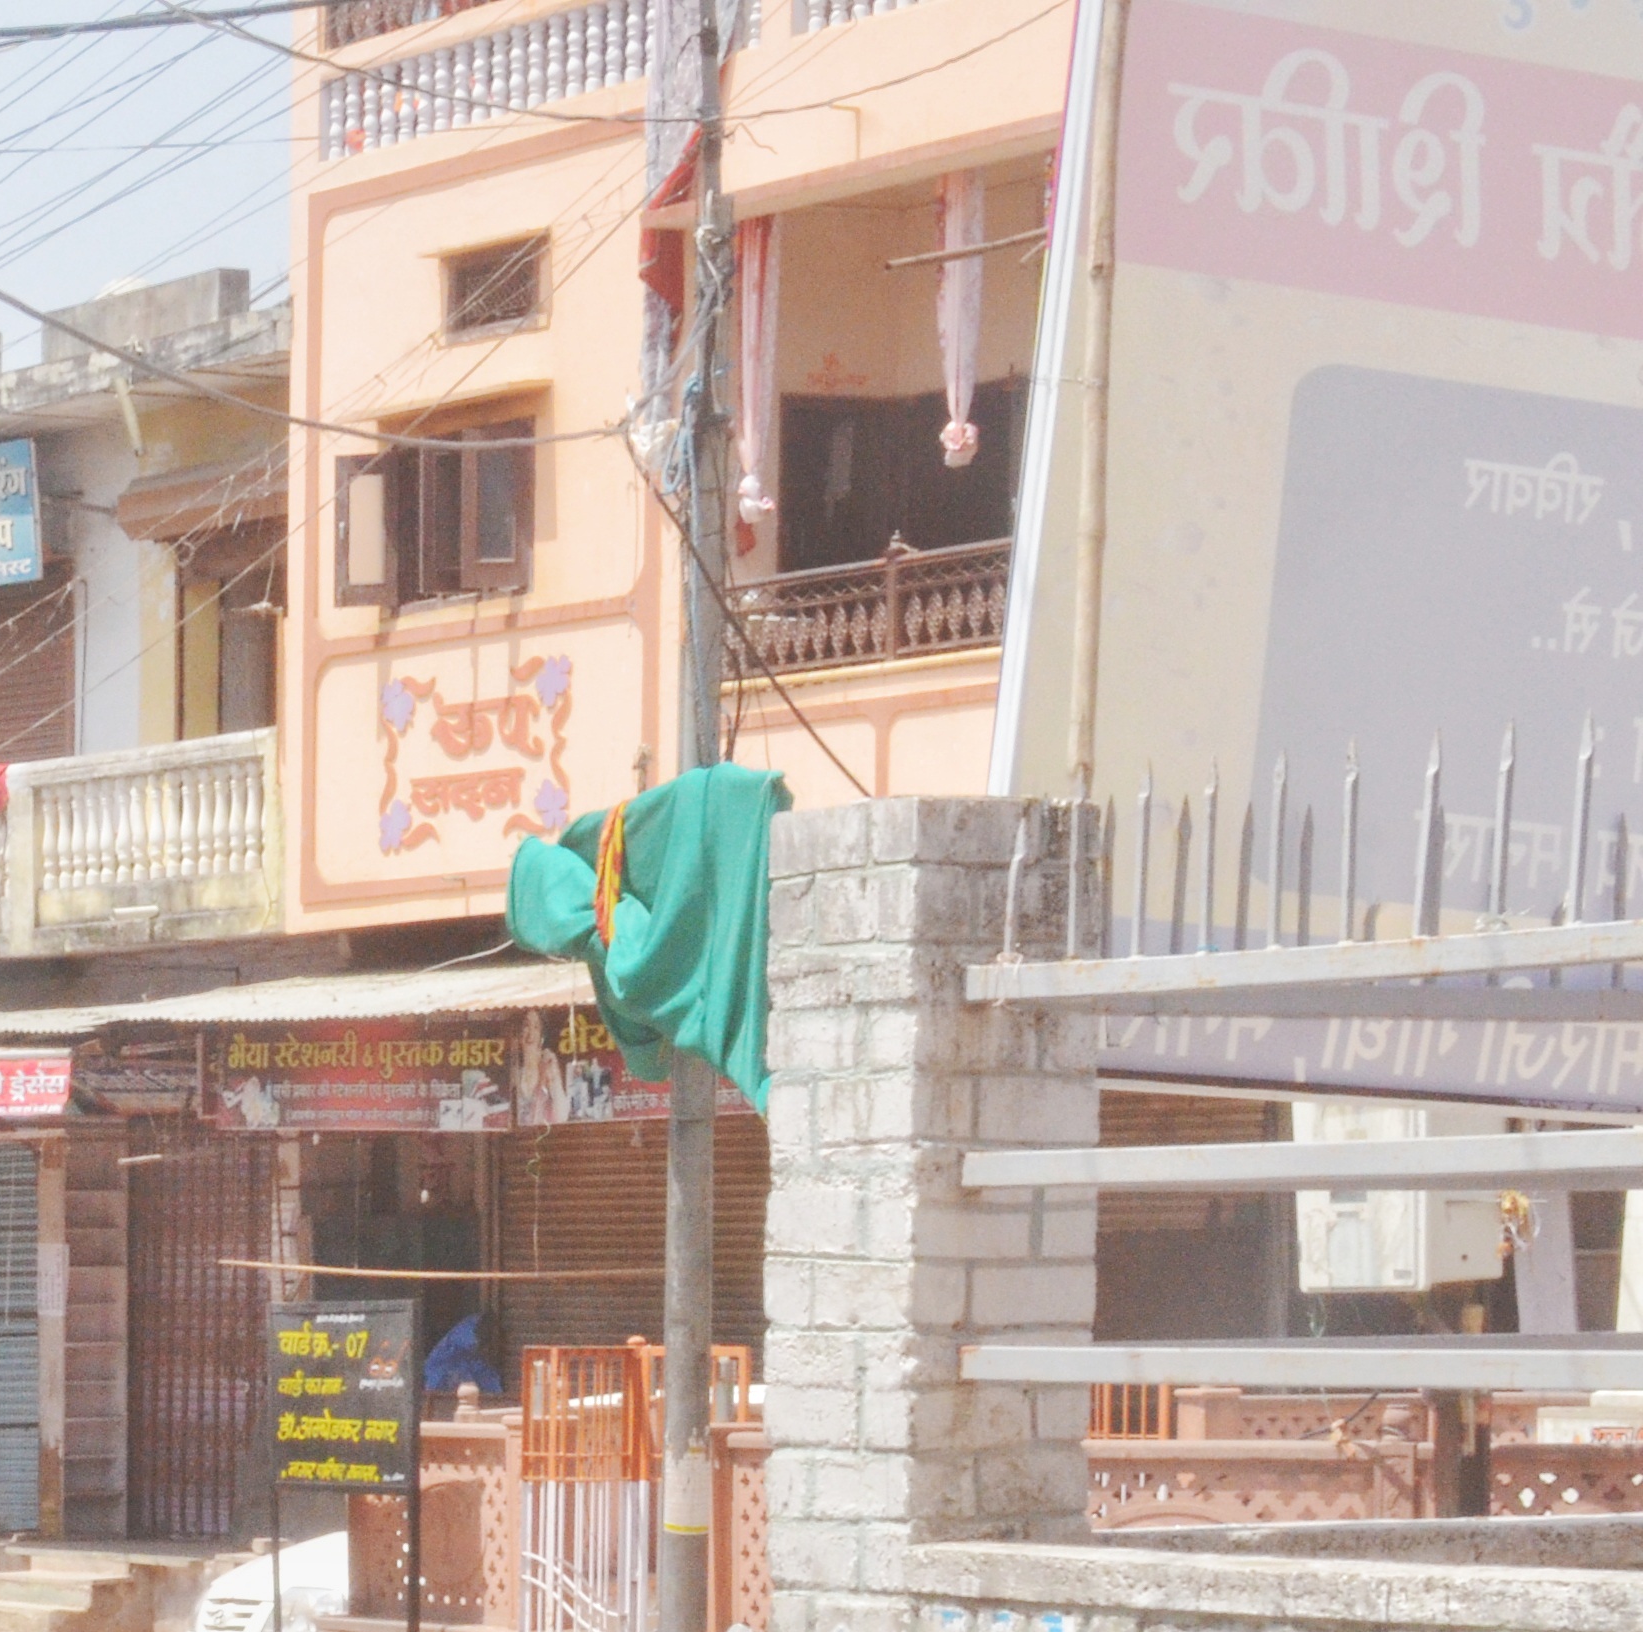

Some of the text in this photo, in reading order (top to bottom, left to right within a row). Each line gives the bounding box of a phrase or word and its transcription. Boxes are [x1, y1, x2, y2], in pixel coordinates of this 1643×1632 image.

[227, 1033, 270, 1069] भैया
[274, 1028, 359, 1069] स्टेशनरी
[377, 1041, 444, 1080] पुस्तक
[448, 1030, 505, 1068] भंडार
[277, 1320, 312, 1355] वार्ड
[345, 1329, 370, 1358] 07
